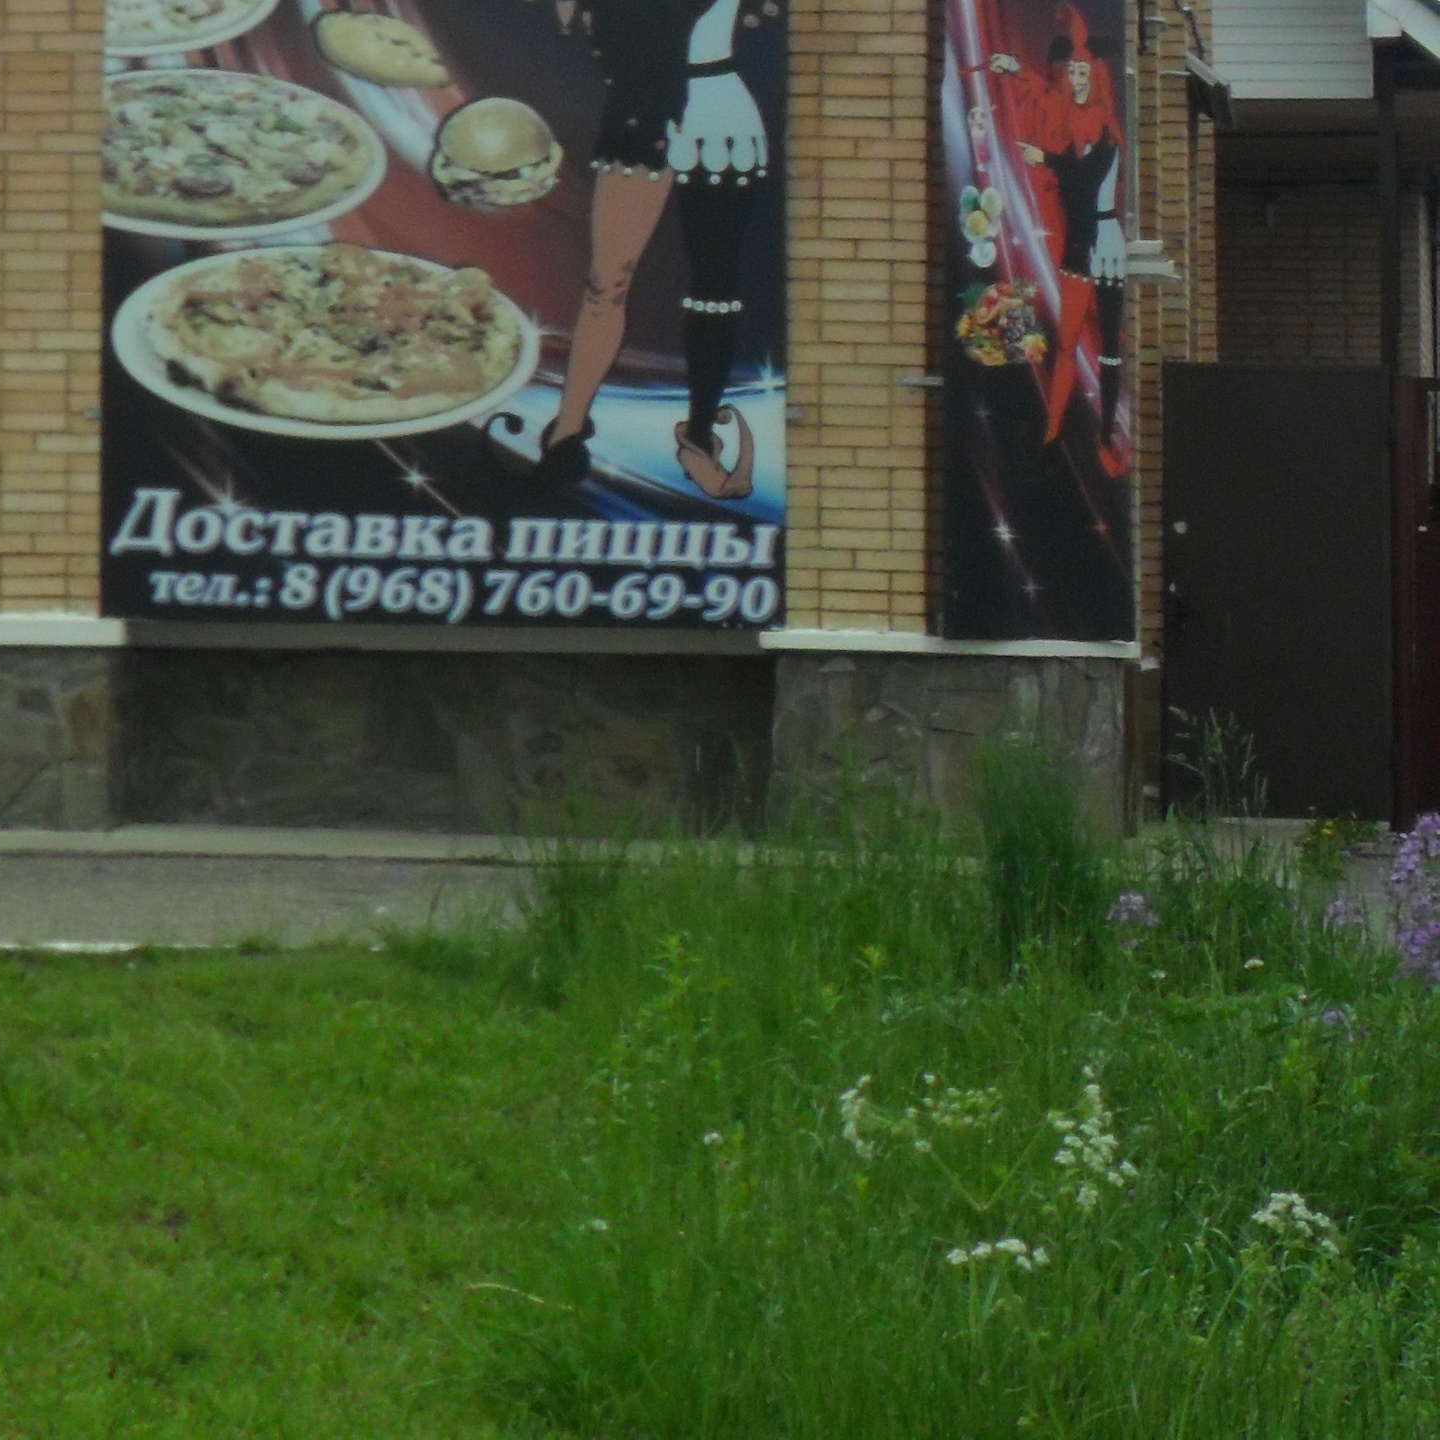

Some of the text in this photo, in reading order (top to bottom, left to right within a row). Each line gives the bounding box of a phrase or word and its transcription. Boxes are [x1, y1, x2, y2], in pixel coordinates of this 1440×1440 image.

[110, 488, 781, 569] Доставка пиццы
[149, 563, 779, 624] тел.: 8 (968) 760-69-90
